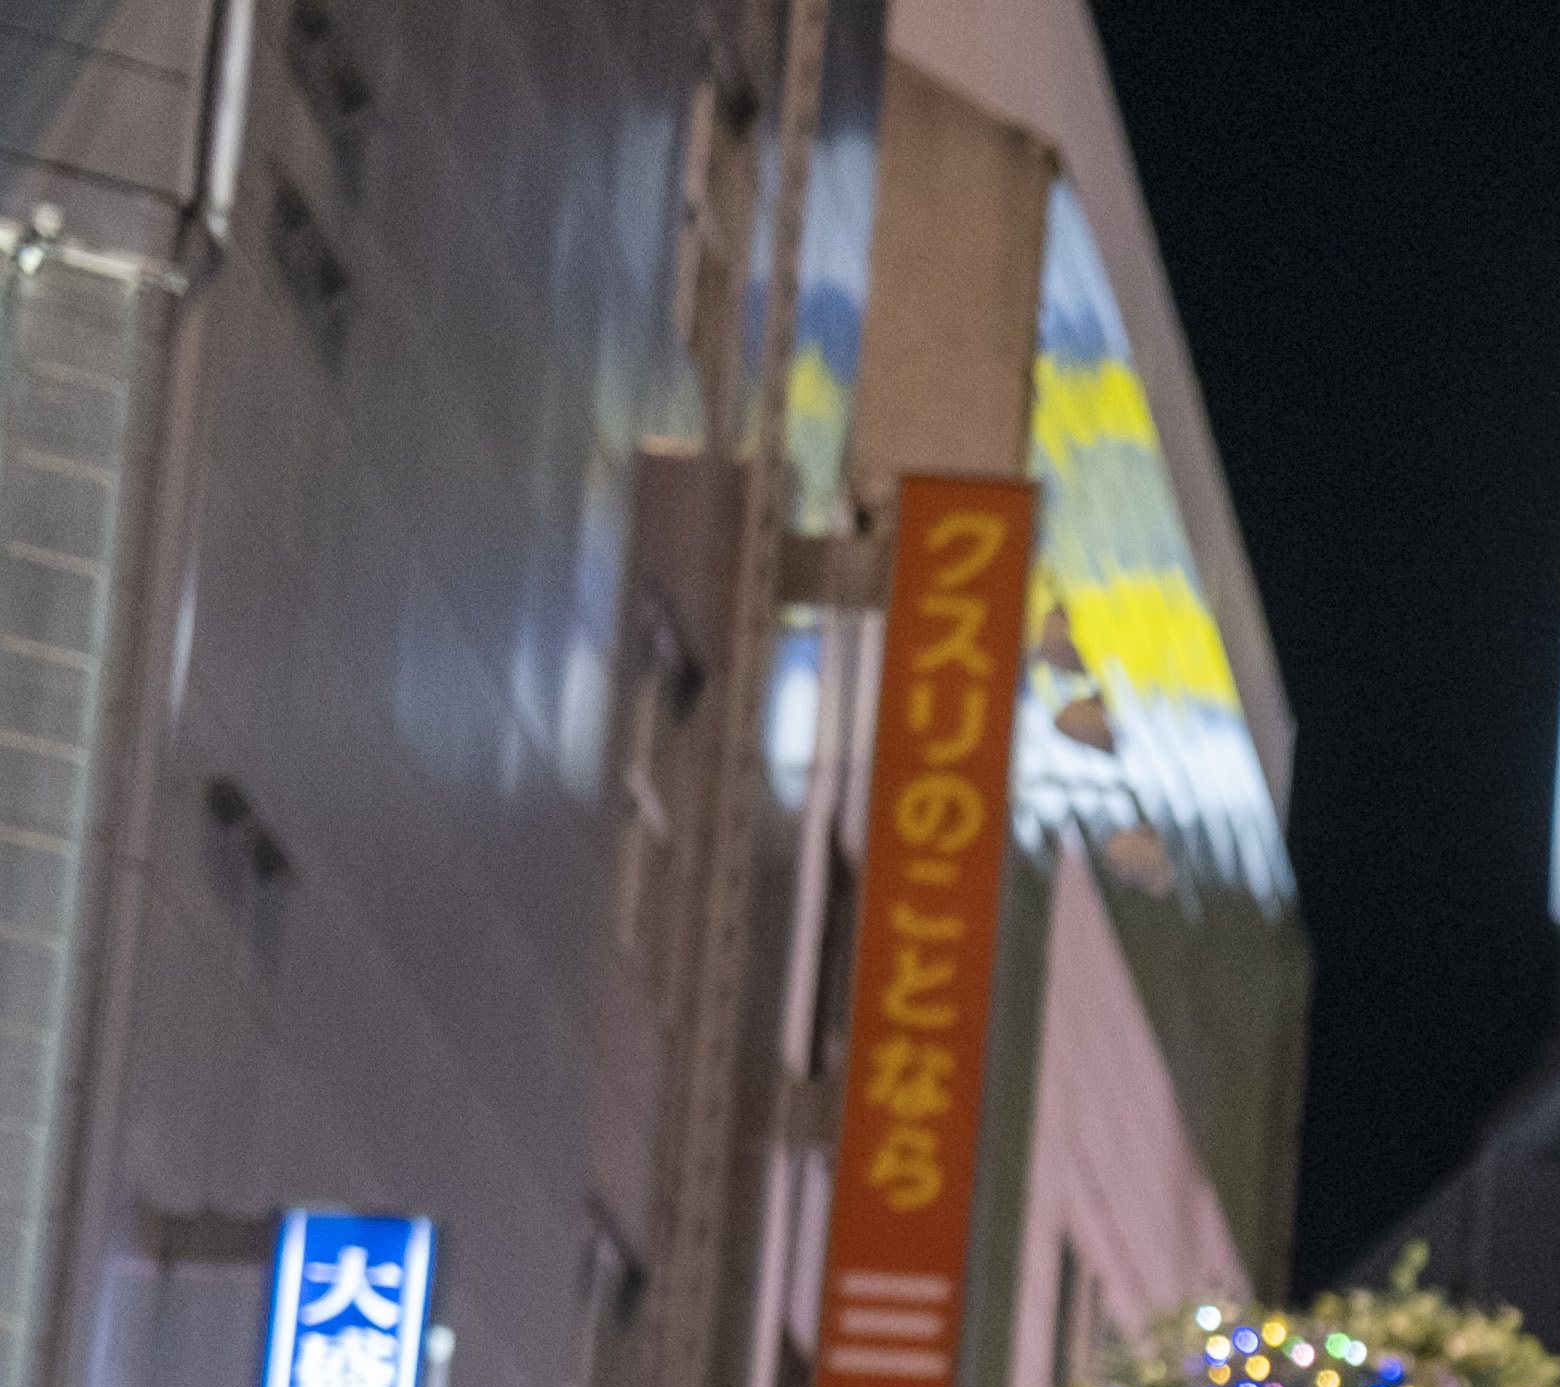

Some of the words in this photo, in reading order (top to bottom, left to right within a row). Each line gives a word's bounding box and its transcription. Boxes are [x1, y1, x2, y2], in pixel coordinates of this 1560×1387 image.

[868, 510, 1002, 1208] クスリのことなら
